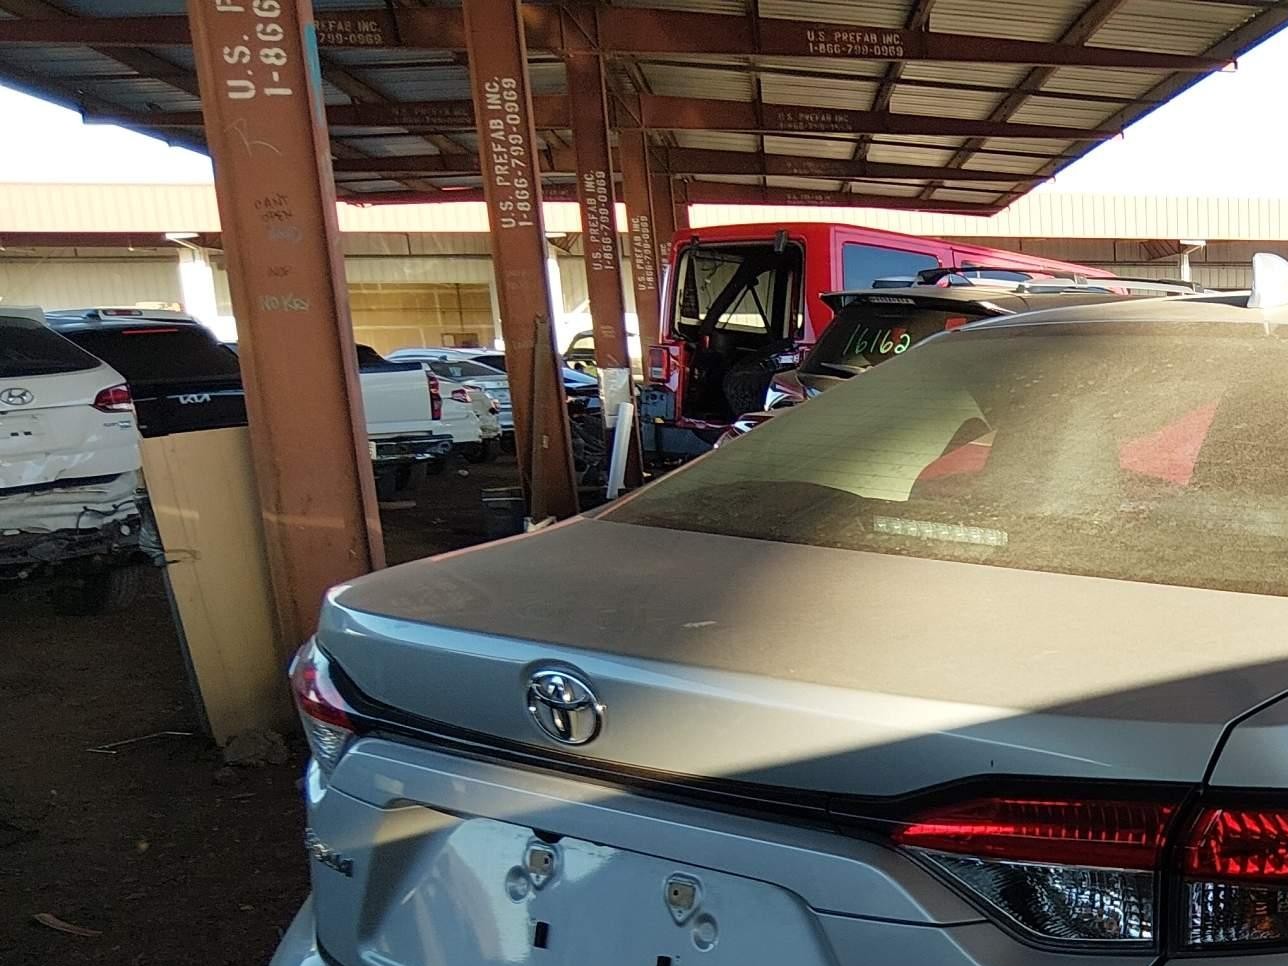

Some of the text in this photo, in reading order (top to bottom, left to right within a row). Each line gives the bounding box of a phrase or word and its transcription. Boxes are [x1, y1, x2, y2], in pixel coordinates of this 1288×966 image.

[834, 31, 877, 44] PREFAB
[882, 33, 904, 45] INC.
[222, 35, 256, 99] U.S.
[485, 76, 517, 228] U.S. PREFAB INC.
[501, 77, 534, 227] 1-866-799-0969
[583, 170, 596, 192] INC.
[586, 198, 600, 243] PREFAB
[842, 323, 911, 356] 16162
